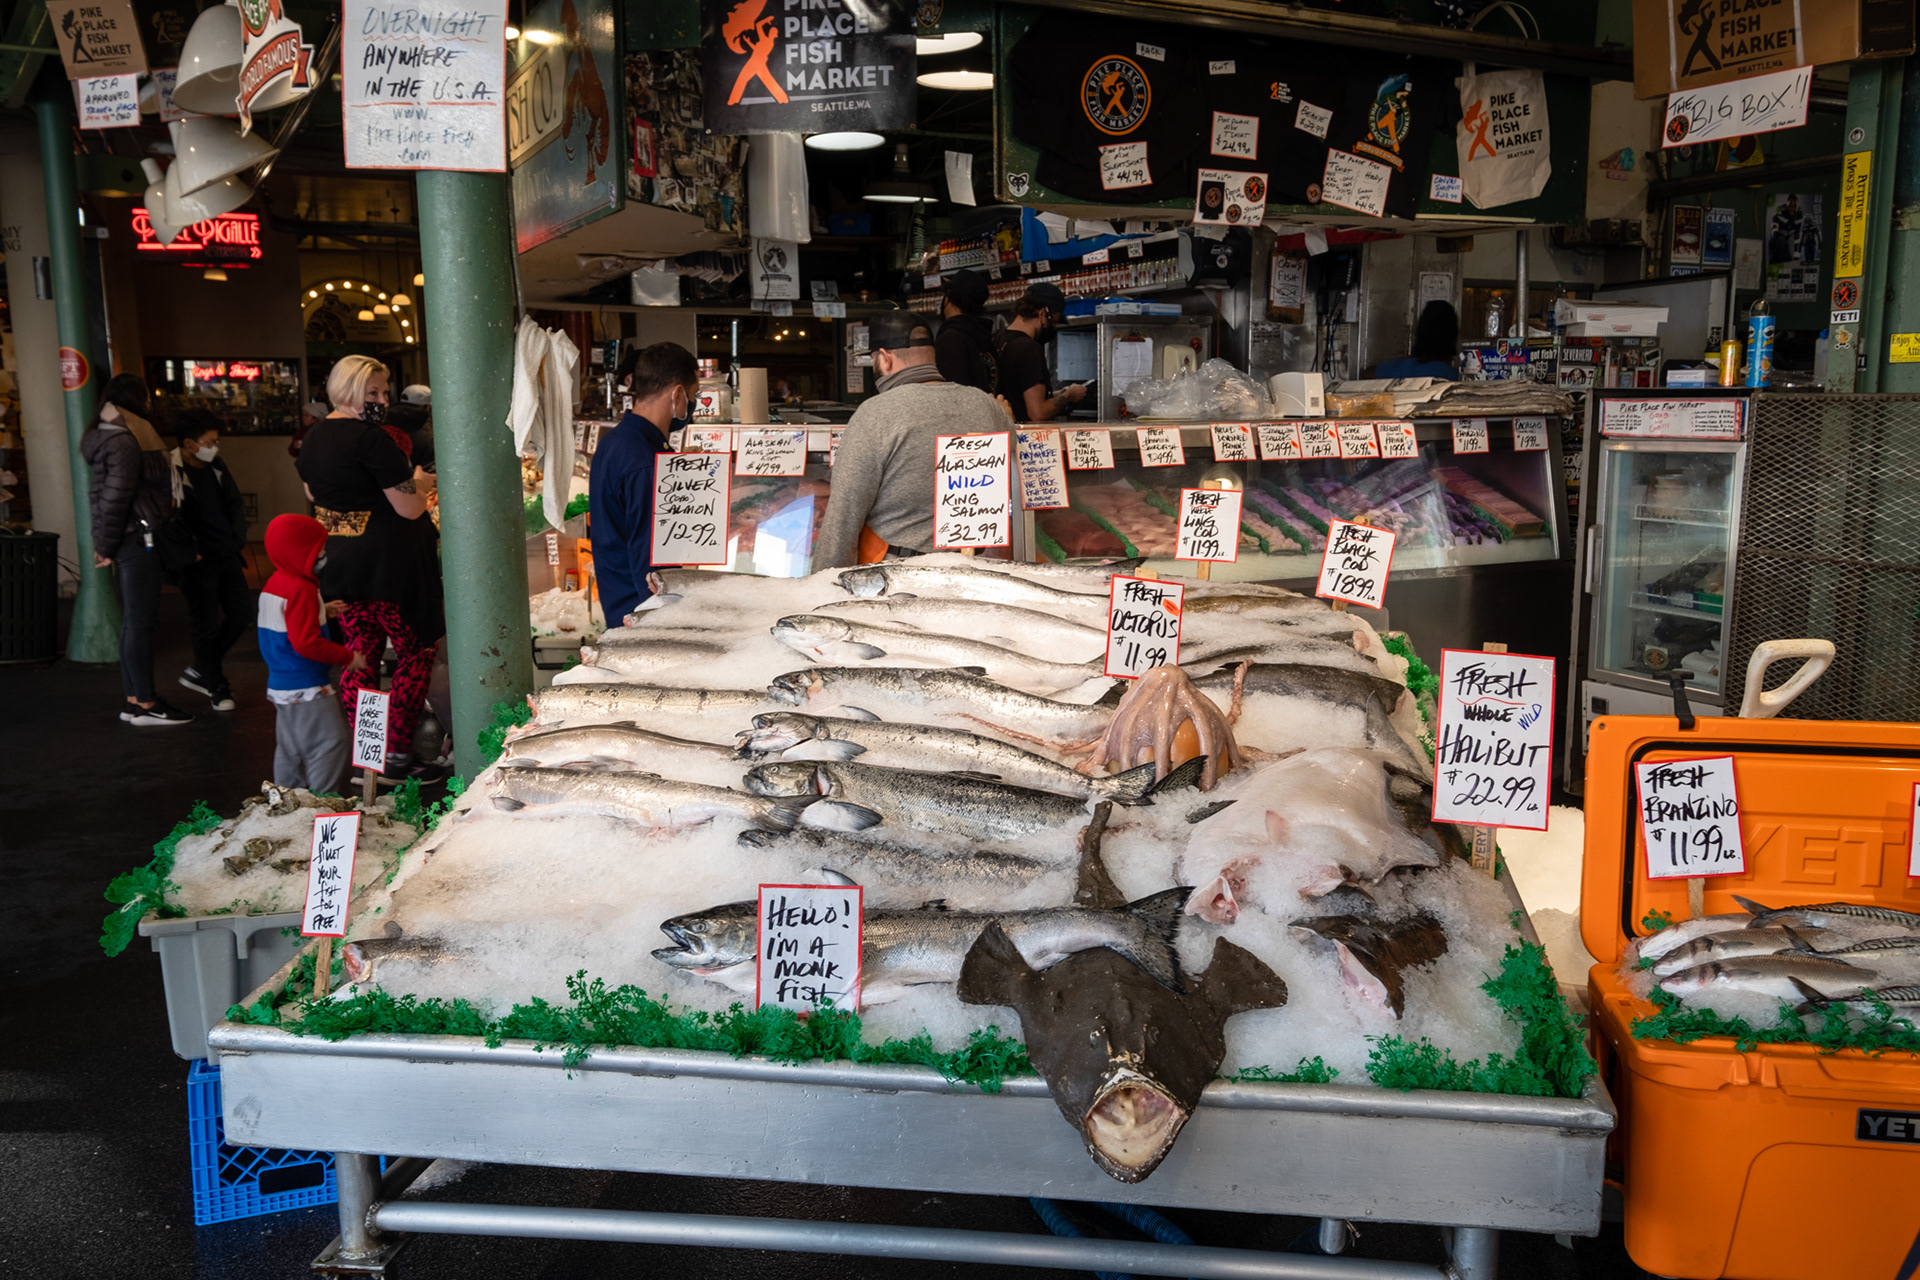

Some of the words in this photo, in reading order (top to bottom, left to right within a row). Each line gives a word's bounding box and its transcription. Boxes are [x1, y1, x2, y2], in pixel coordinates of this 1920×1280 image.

[80, 7, 102, 18] PIKE
[362, 7, 498, 36] OVERNIGHT
[83, 19, 117, 31] PLACE
[784, 13, 869, 37] PLACE
[1721, 14, 1760, 38] FISH
[87, 32, 109, 44] FISH
[1721, 28, 1796, 59] MARKET
[91, 44, 132, 57] MARKET
[263, 37, 298, 76] FAMOUS
[363, 43, 467, 74] ANYWHERE
[785, 41, 842, 65] FISH
[88, 78, 118, 91] TSA
[786, 65, 894, 91] MARKET
[1090, 63, 1111, 88] PIKE
[1115, 62, 1140, 90] PLACE
[85, 91, 130, 104] APPROVED
[365, 78, 381, 98] IN
[387, 79, 424, 98] THE
[532, 60, 557, 136] CO.
[811, 100, 871, 112] SEATTLE,WA
[1490, 92, 1515, 107] PIKE
[1669, 95, 1696, 115] THE
[1090, 100, 1105, 123] FISH
[1109, 104, 1143, 128] MARKET
[1492, 104, 1530, 121] PLACE
[1690, 95, 1733, 133] BIG
[1493, 121, 1520, 136] FISH
[1495, 130, 1543, 149] MARKET
[1707, 214, 1732, 223] CLEAN
[1833, 311, 1858, 322] YETI
[1620, 403, 1637, 413] PIKE
[1641, 403, 1660, 412] PLACE
[745, 437, 792, 448] ALASKAN
[945, 437, 993, 451] FRESH
[666, 455, 716, 472] FRESH
[935, 453, 1006, 473] ALASKAN
[658, 474, 721, 494] SILVER
[948, 474, 995, 490] WILD
[653, 498, 715, 516] SALMON
[942, 493, 979, 506] KING
[950, 503, 1004, 518] SALMON
[1184, 514, 1215, 527] LING
[1194, 525, 1219, 538] COD
[1330, 537, 1380, 562] BLACK
[1342, 556, 1368, 571] COD
[1123, 581, 1176, 606] FRESH
[1112, 609, 1177, 638] OCTOPUS
[1450, 662, 1537, 699] FRESH
[1463, 704, 1518, 722] WHOLE
[1438, 723, 1550, 768] HALIBUT
[1645, 763, 1714, 793] FRESH
[1443, 769, 1535, 811] $22.99
[1644, 793, 1737, 824] BRANZINO
[321, 817, 341, 844] WE
[1735, 823, 1907, 888] YET
[318, 865, 341, 884] YOUR
[766, 896, 850, 930] HELLO!
[809, 936, 839, 958] A
[774, 959, 843, 979] MONK
